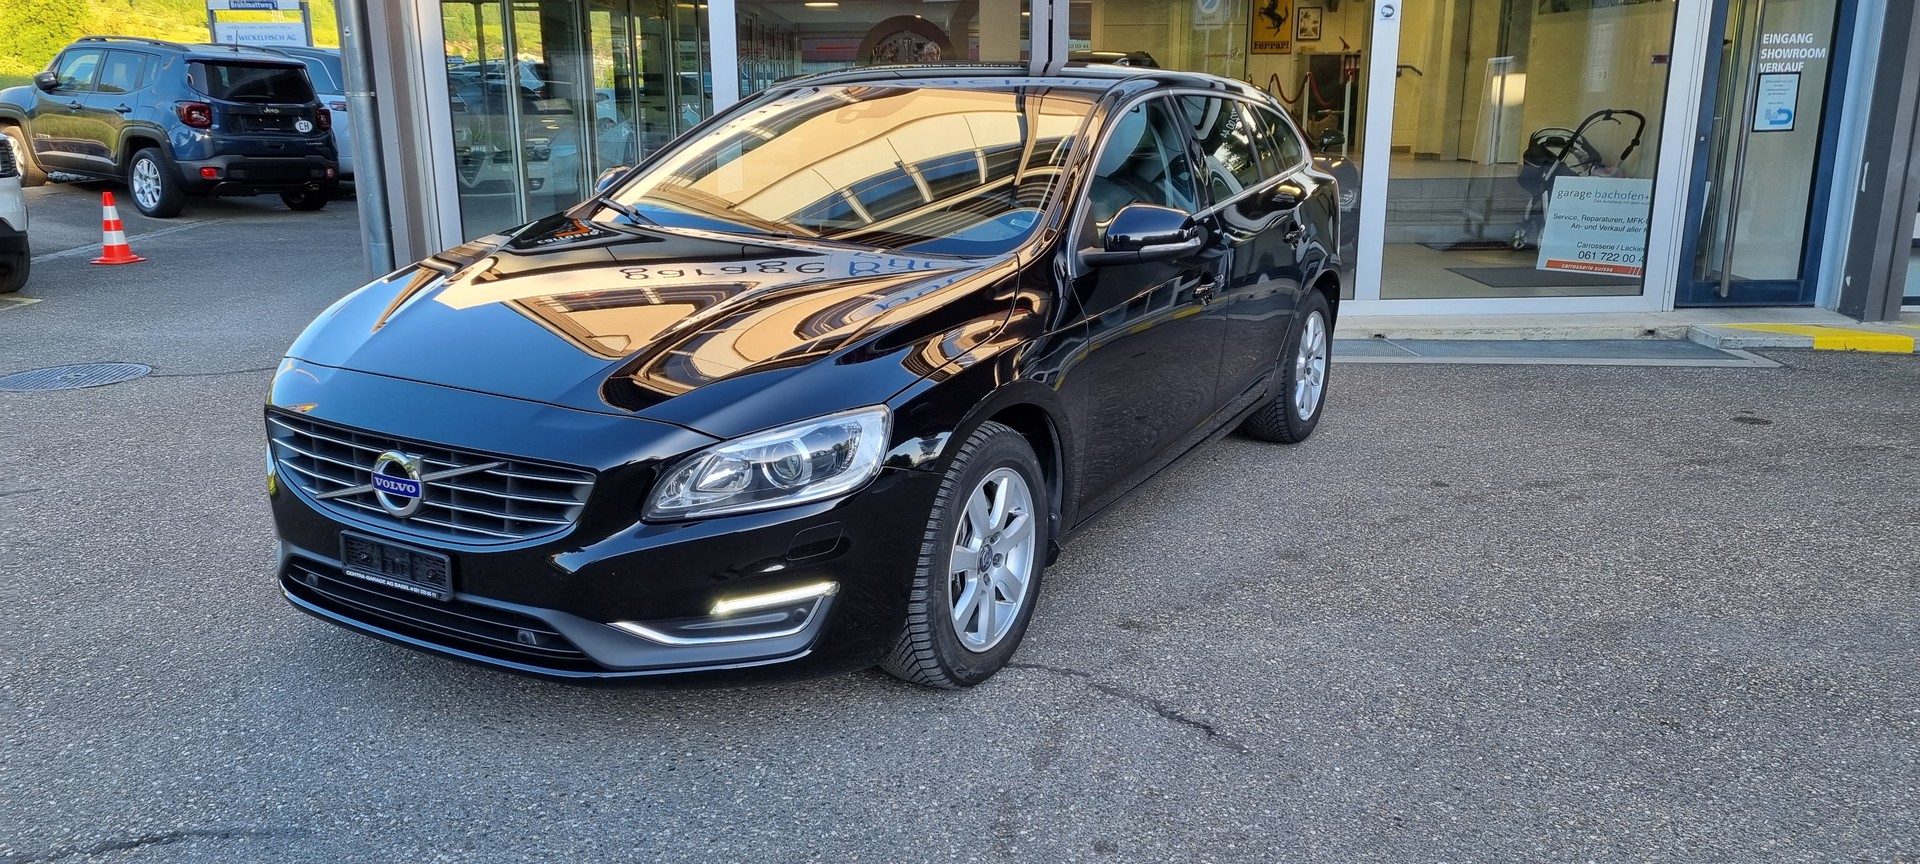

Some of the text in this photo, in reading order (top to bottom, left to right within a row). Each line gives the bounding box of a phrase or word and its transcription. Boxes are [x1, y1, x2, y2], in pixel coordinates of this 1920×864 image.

[230, 1, 272, 9] Brühlmattweg
[1762, 33, 1814, 44] EINGANG
[1254, 41, 1289, 49] Ferrari
[1760, 47, 1826, 59] SHOWROOM
[1759, 61, 1804, 72] VERKAUF
[299, 120, 310, 131] CH
[1557, 190, 1592, 200] garage
[1553, 213, 1579, 221] Service,
[1581, 215, 1625, 223] Reparaturen,
[1577, 242, 1615, 250] Carrosserie
[1578, 251, 1597, 260] 061
[1600, 252, 1620, 262] 722
[1622, 253, 1636, 263] 00
[374, 476, 416, 494] VOLVO
